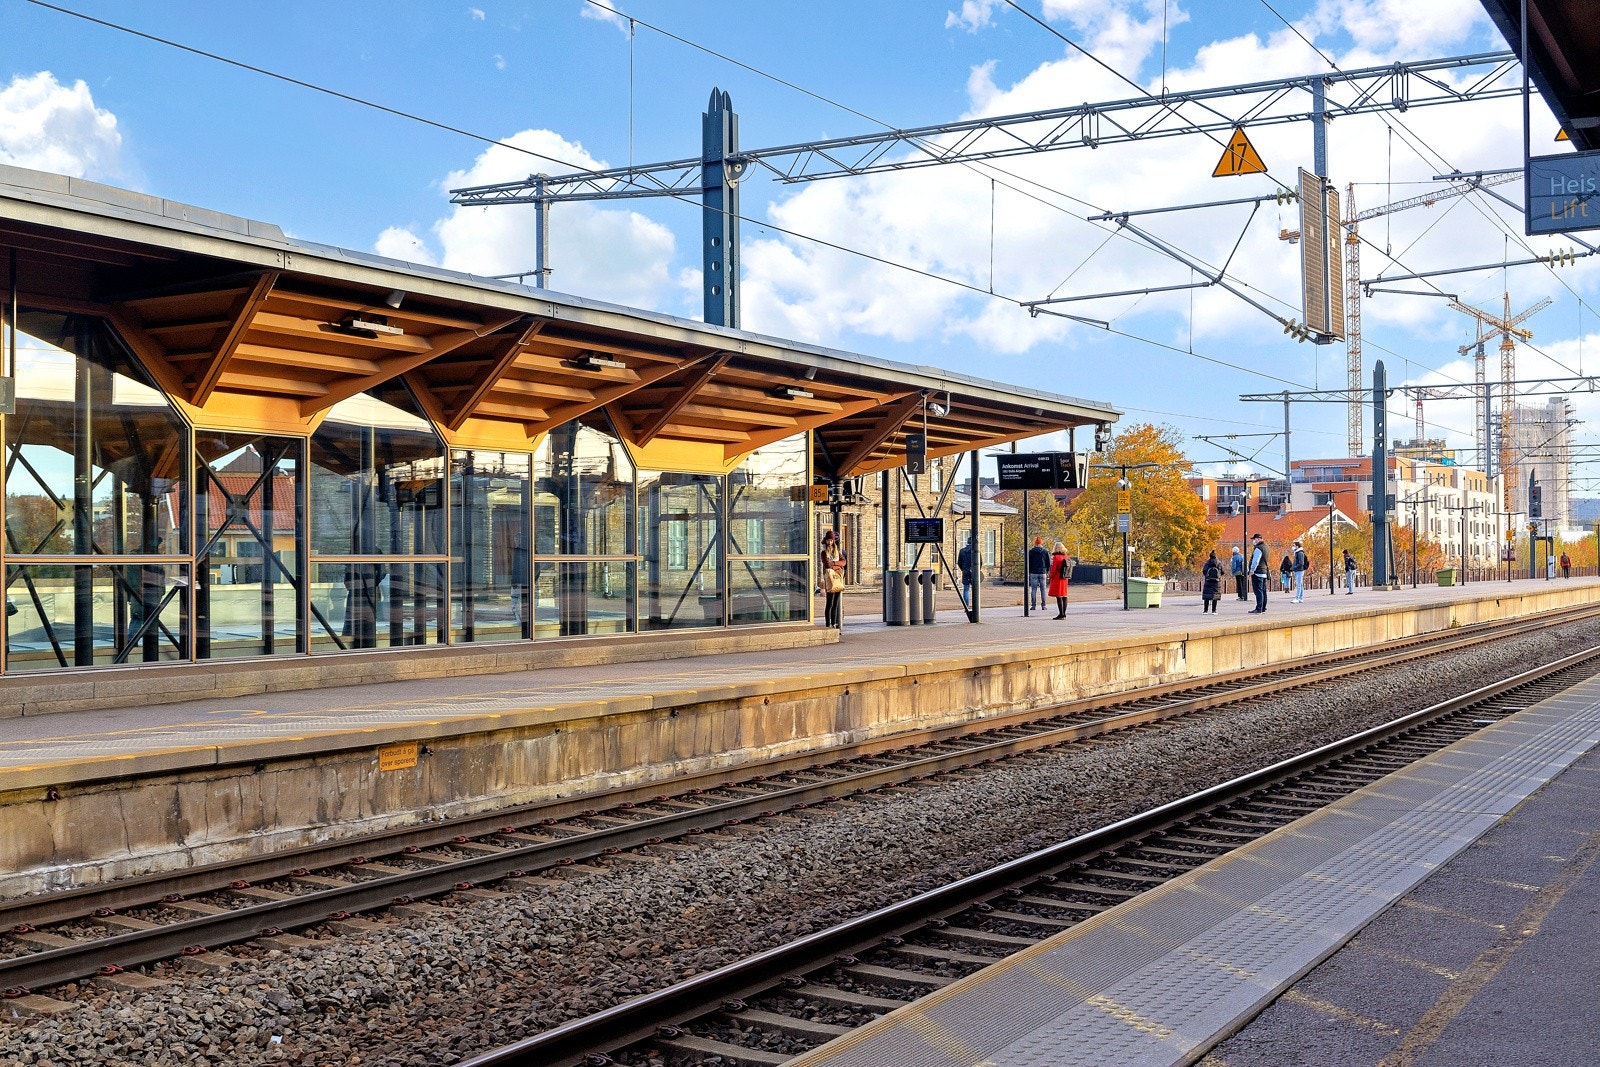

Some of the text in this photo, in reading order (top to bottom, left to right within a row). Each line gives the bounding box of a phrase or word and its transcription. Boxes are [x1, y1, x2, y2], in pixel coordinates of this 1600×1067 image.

[1230, 143, 1247, 171] 17
[1550, 174, 1596, 195] Heis
[1551, 198, 1588, 219] Lift
[913, 461, 919, 471] 2
[1063, 470, 1070, 482] 2
